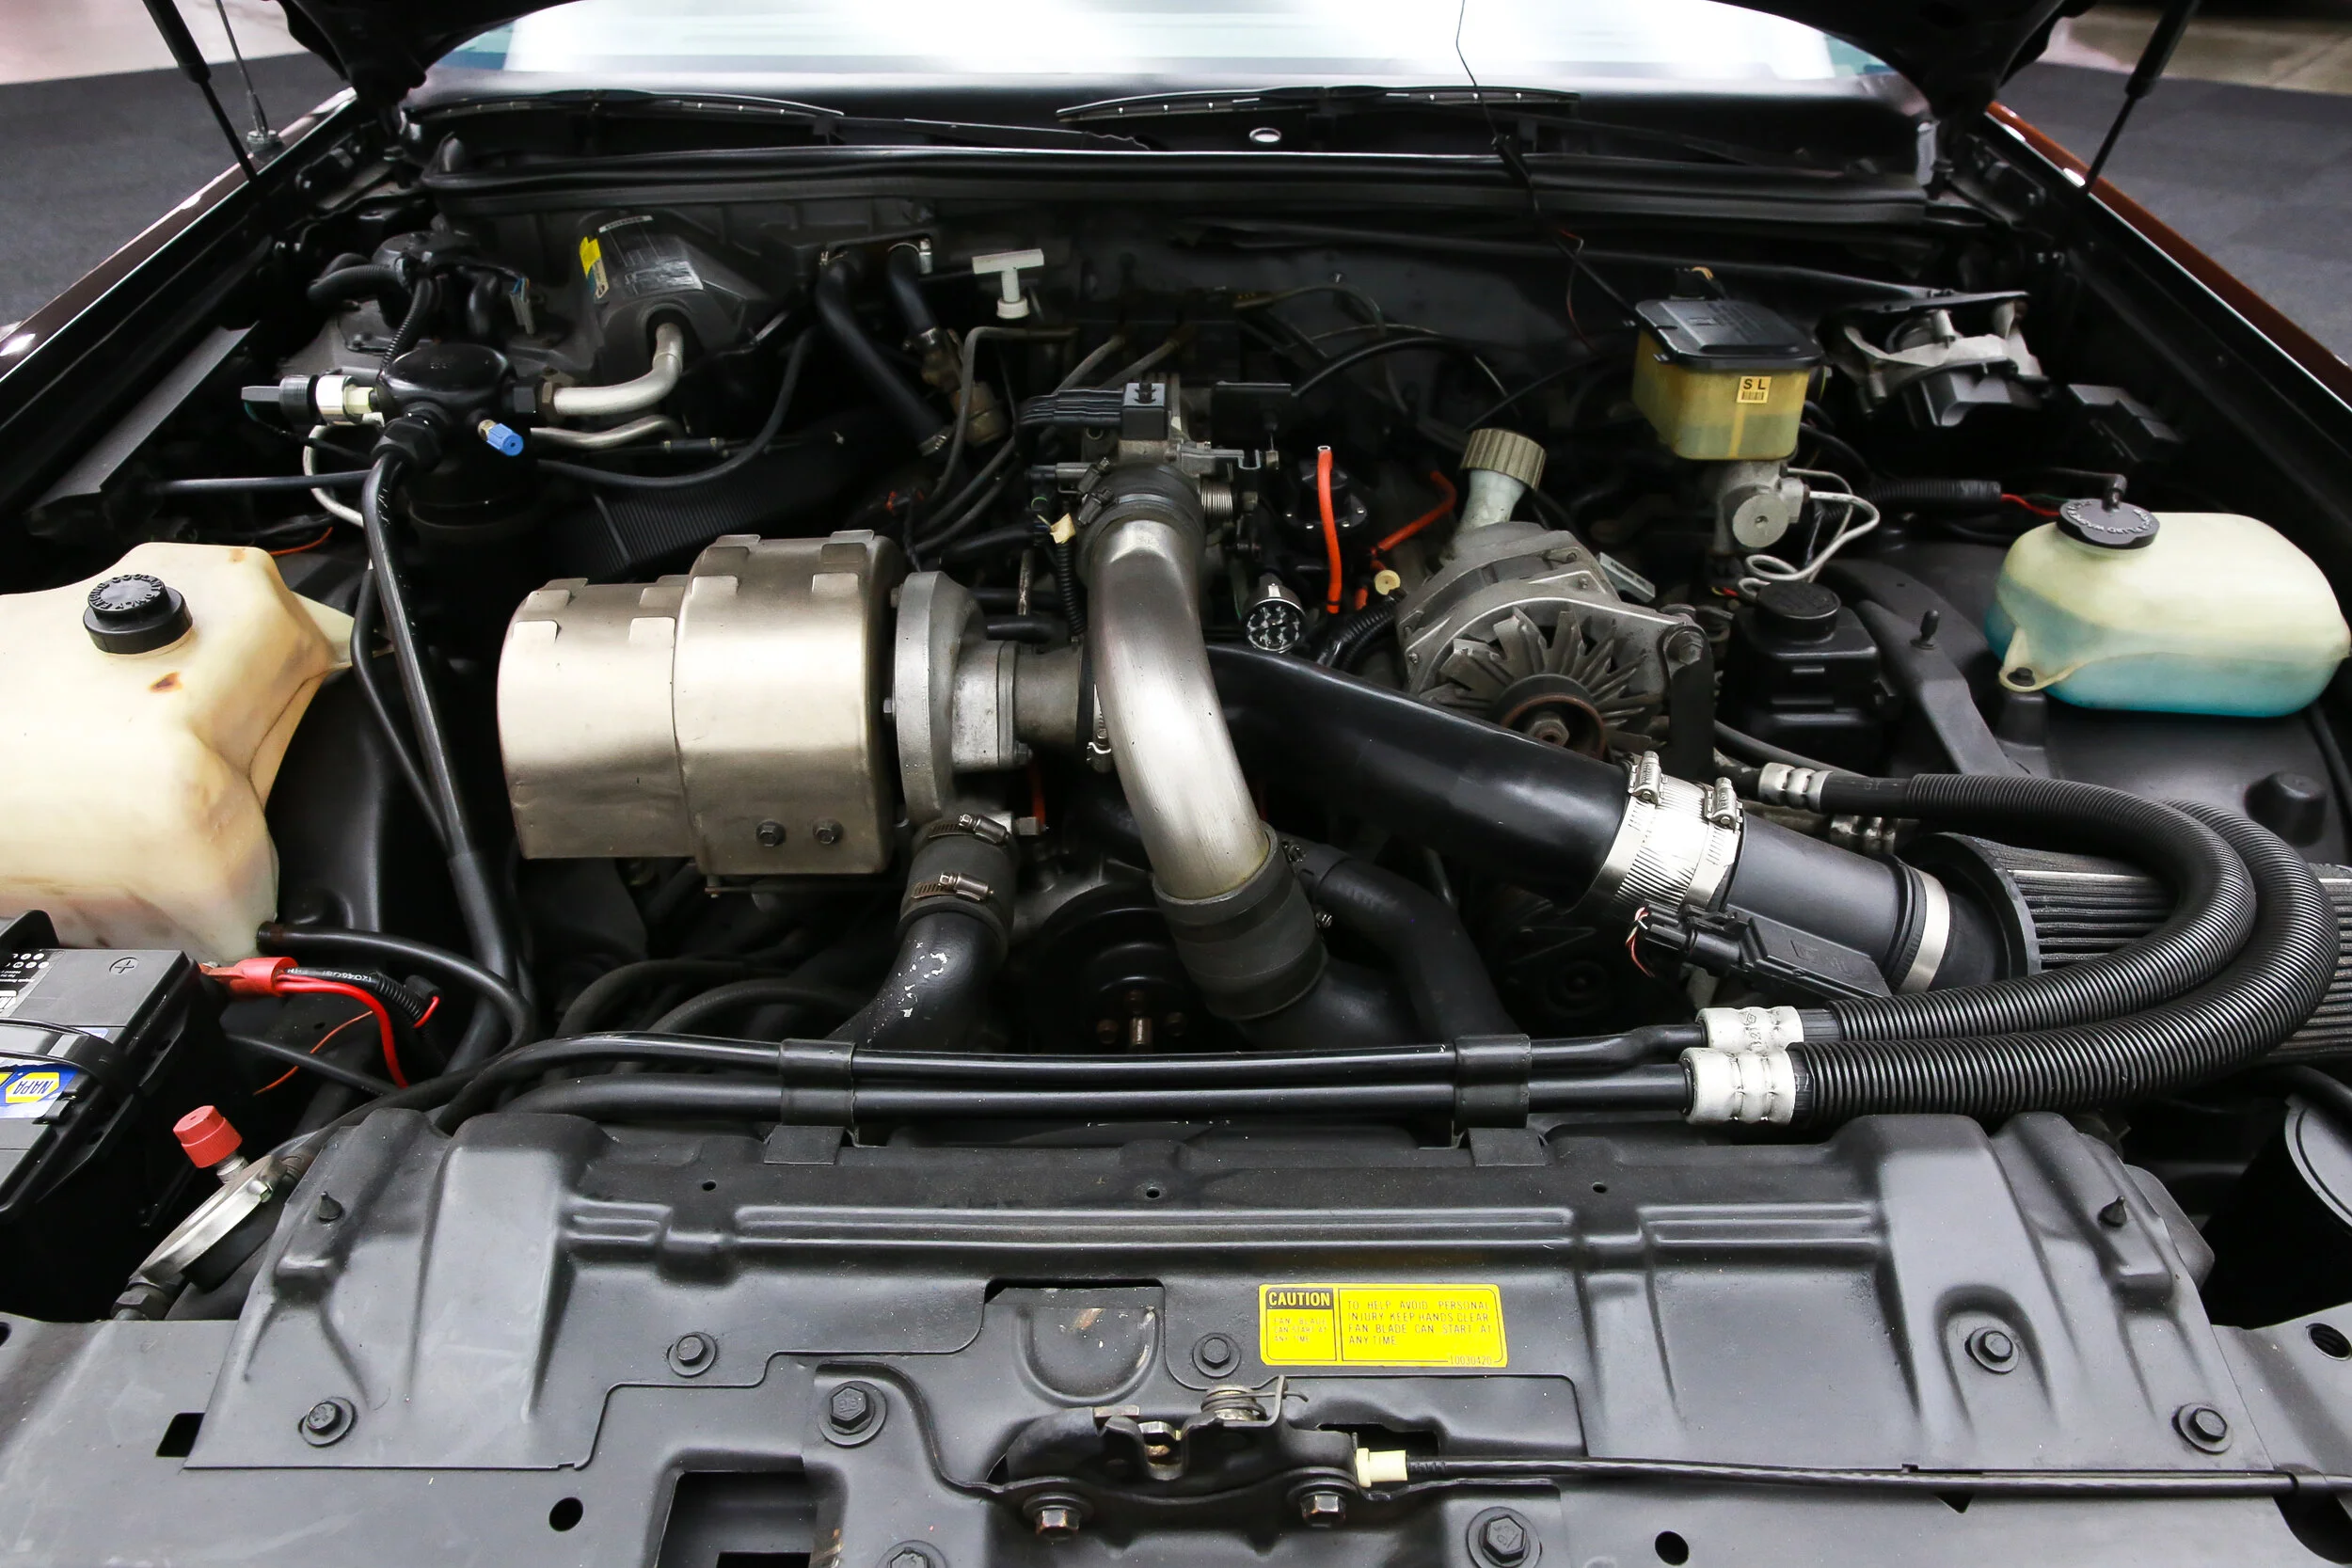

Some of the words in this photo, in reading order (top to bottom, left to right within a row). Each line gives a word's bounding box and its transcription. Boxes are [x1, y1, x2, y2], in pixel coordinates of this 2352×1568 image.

[1743, 378, 1753, 390] S
[1757, 378, 1767, 390] L
[13, 1080, 54, 1095] NAPA
[1267, 1291, 1331, 1307] CAUTION
[1347, 1301, 1359, 1310] TO
[1367, 1301, 1391, 1310] HELP
[1400, 1301, 1428, 1310] AVOID
[1438, 1301, 1490, 1310] PERSONAL
[1348, 1312, 1384, 1322] INJURY
[1391, 1312, 1415, 1322] KEEP
[1419, 1312, 1454, 1322] HANDS
[1457, 1312, 1488, 1322] CLEAR
[1348, 1323, 1369, 1334] FAN
[1376, 1323, 1407, 1334] BLADE
[1415, 1323, 1435, 1334] CAN
[1442, 1323, 1472, 1334] START
[1481, 1323, 1492, 1334] AT
[1349, 1336, 1369, 1345] ANY
[1373, 1336, 1397, 1345] TIME
